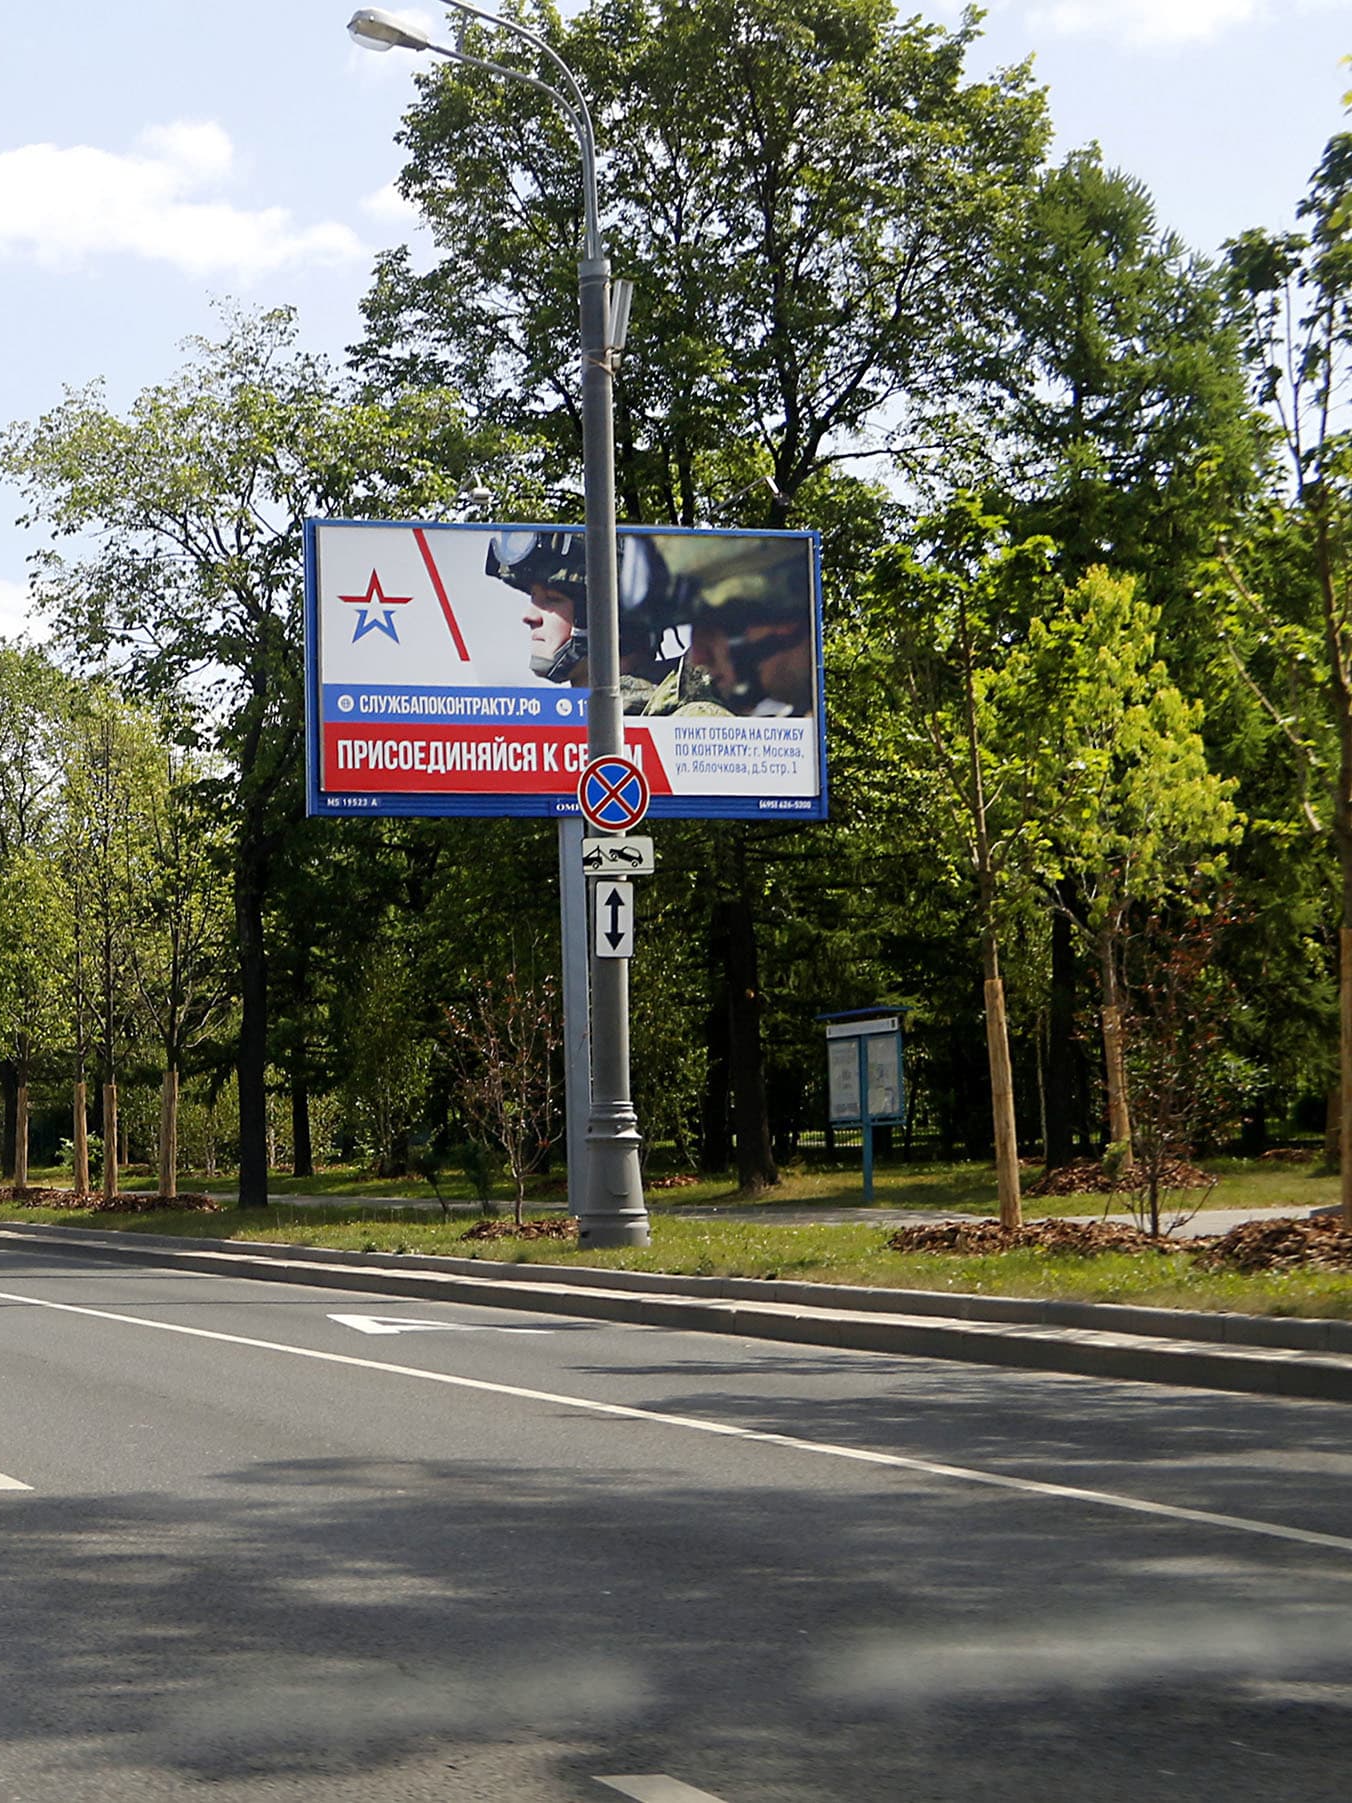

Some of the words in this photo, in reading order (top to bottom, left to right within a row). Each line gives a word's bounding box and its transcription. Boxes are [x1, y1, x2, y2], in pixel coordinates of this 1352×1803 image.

[359, 694, 541, 716] СЛУЖБАПОКОНТРАКТУ.РФ
[674, 727, 706, 740] ПУНКТ
[709, 727, 747, 740] ОТБОРА
[749, 728, 762, 740] НА
[763, 728, 804, 741] СЛУЖБУ
[337, 736, 537, 774] ПРИСОЕДИНЯЙСЯ
[543, 743, 559, 772] К
[675, 744, 689, 756] ПО
[691, 744, 751, 757] КОНТРАКТУ:
[753, 748, 761, 757] г.
[763, 745, 805, 759] Москва,
[675, 762, 690, 775] ул.
[692, 760, 751, 775] Яблочкова,
[769, 762, 790, 776] стр.
[792, 761, 798, 774] 1
